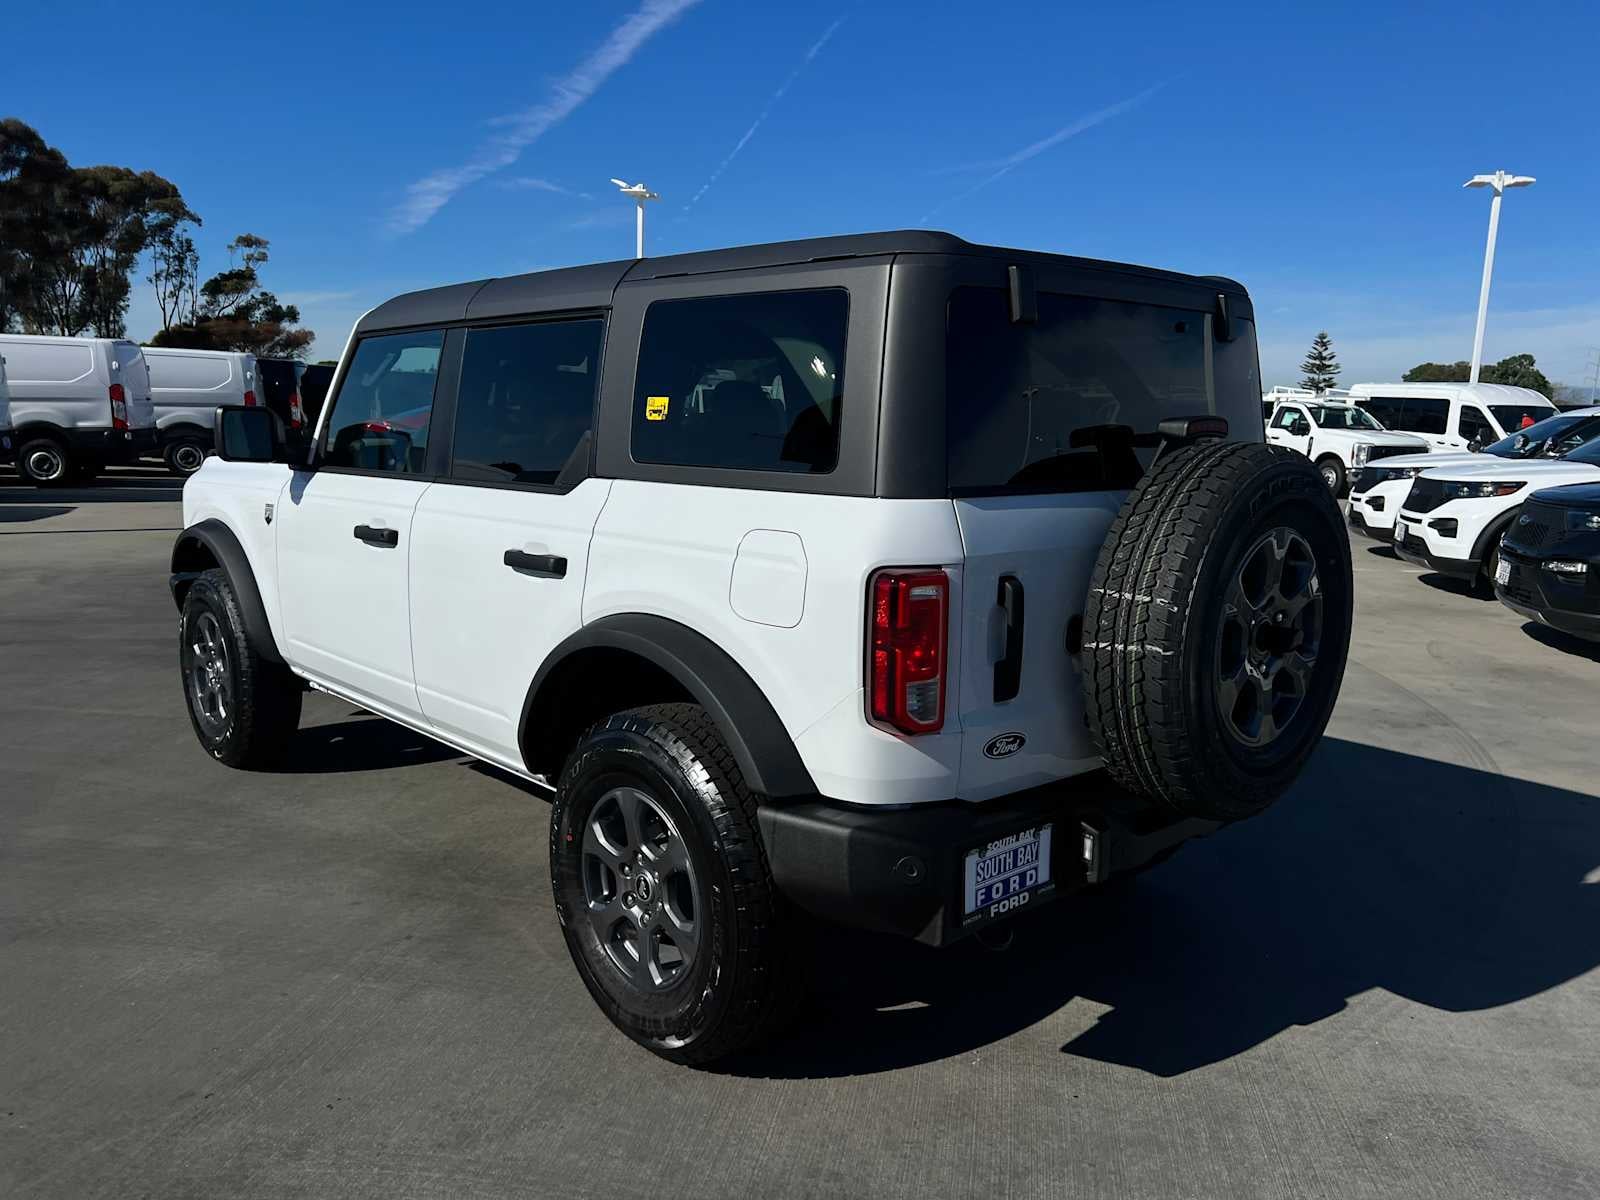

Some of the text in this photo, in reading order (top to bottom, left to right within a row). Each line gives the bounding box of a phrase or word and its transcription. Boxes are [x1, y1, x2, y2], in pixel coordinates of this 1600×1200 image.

[992, 737, 1021, 755] Ford
[986, 828, 1036, 852] SOUTH BAY
[976, 842, 1039, 882] SOUTH BAY
[977, 869, 1037, 906] FORD
[990, 892, 1029, 917] FORD
